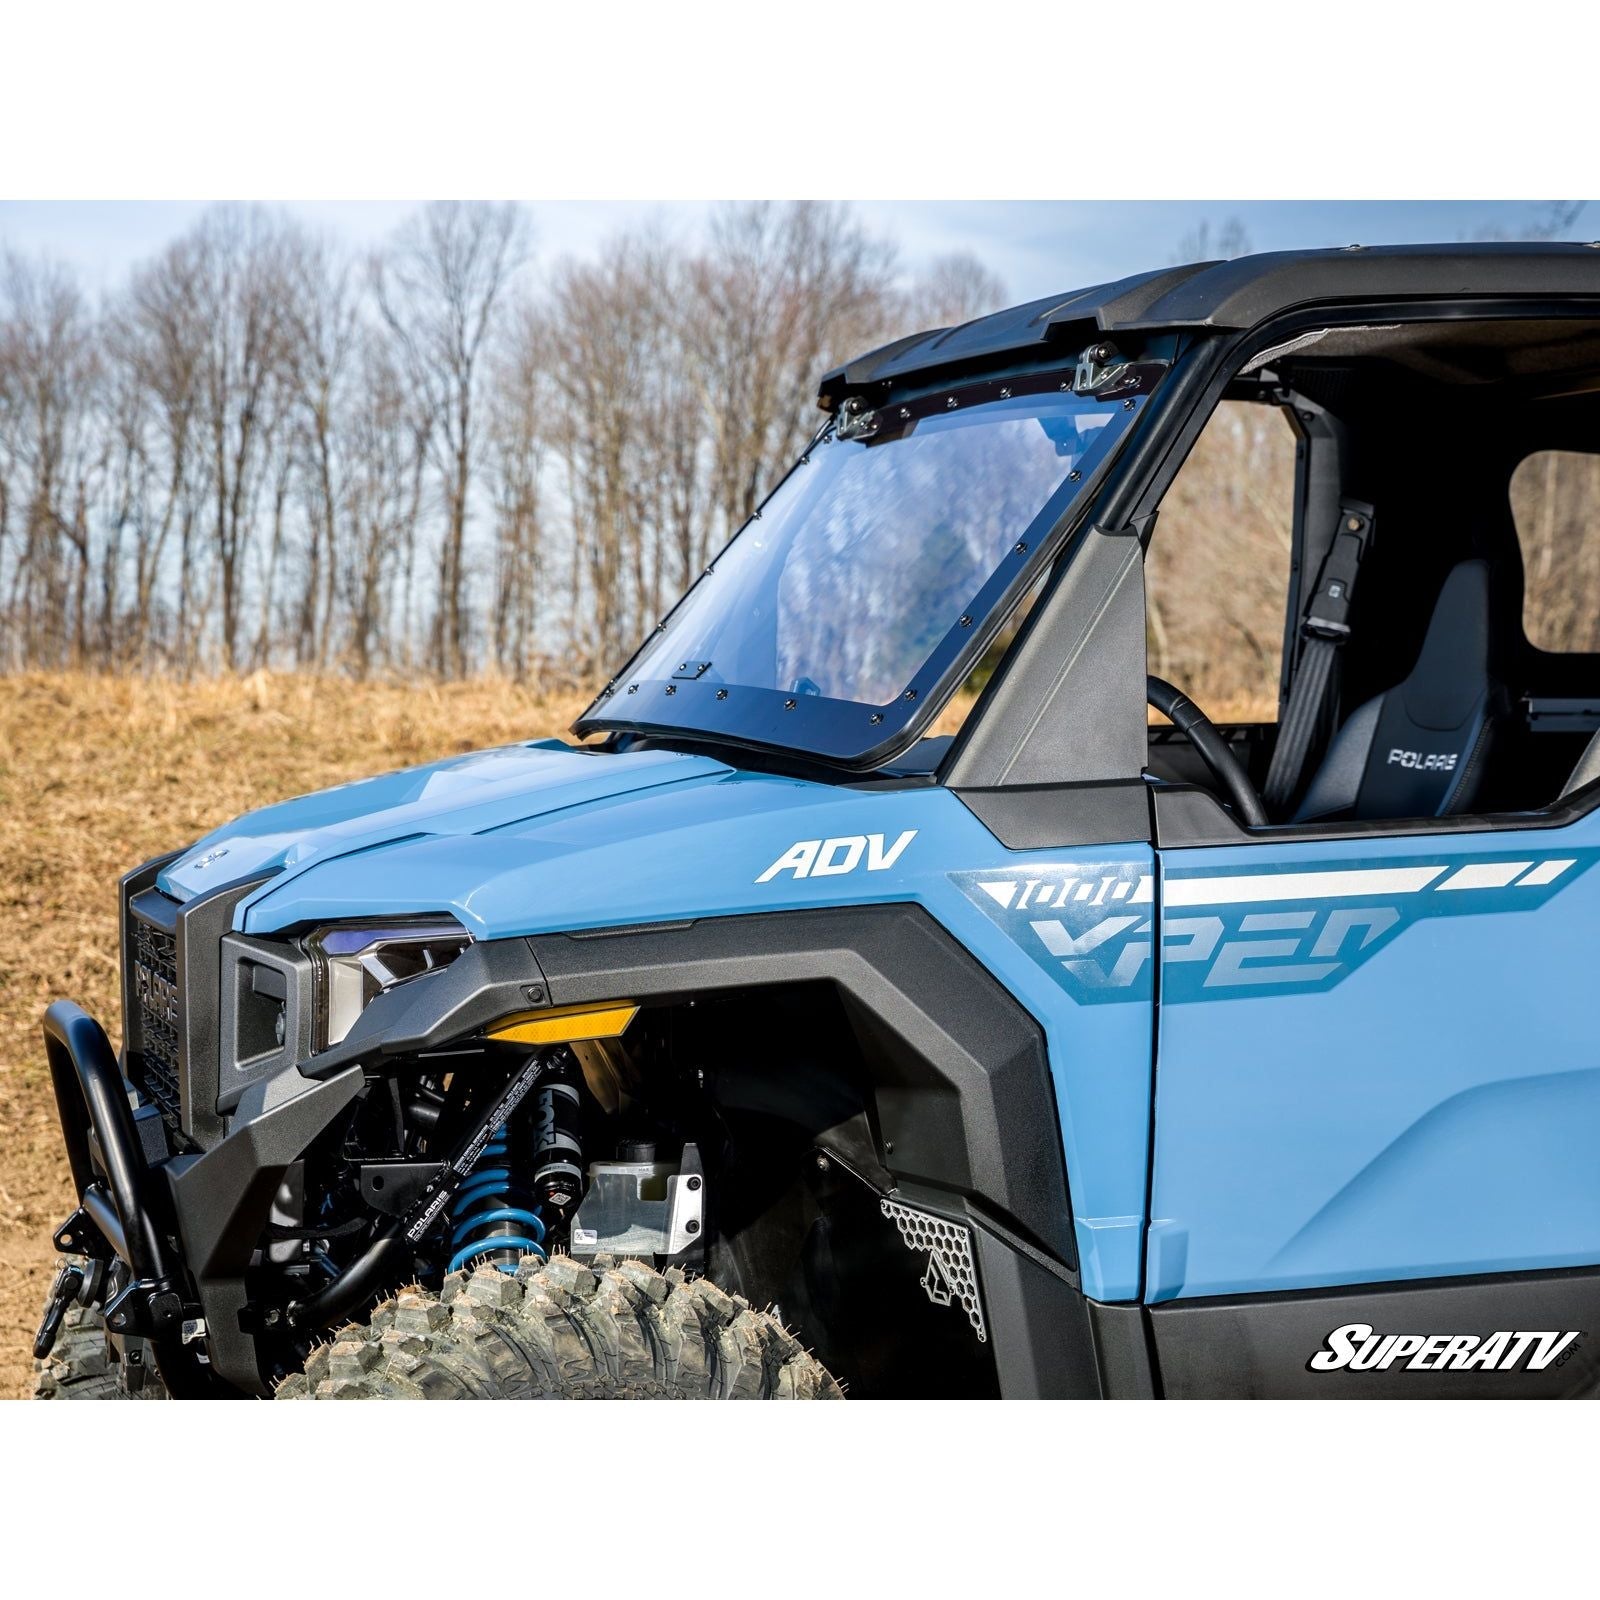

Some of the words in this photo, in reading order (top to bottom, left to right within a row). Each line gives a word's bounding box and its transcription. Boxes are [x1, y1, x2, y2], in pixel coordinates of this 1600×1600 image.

[1386, 748, 1459, 771] POLARIS
[752, 829, 920, 884] ADV
[536, 1088, 557, 1150] FOX
[406, 1189, 448, 1238] POLARIS
